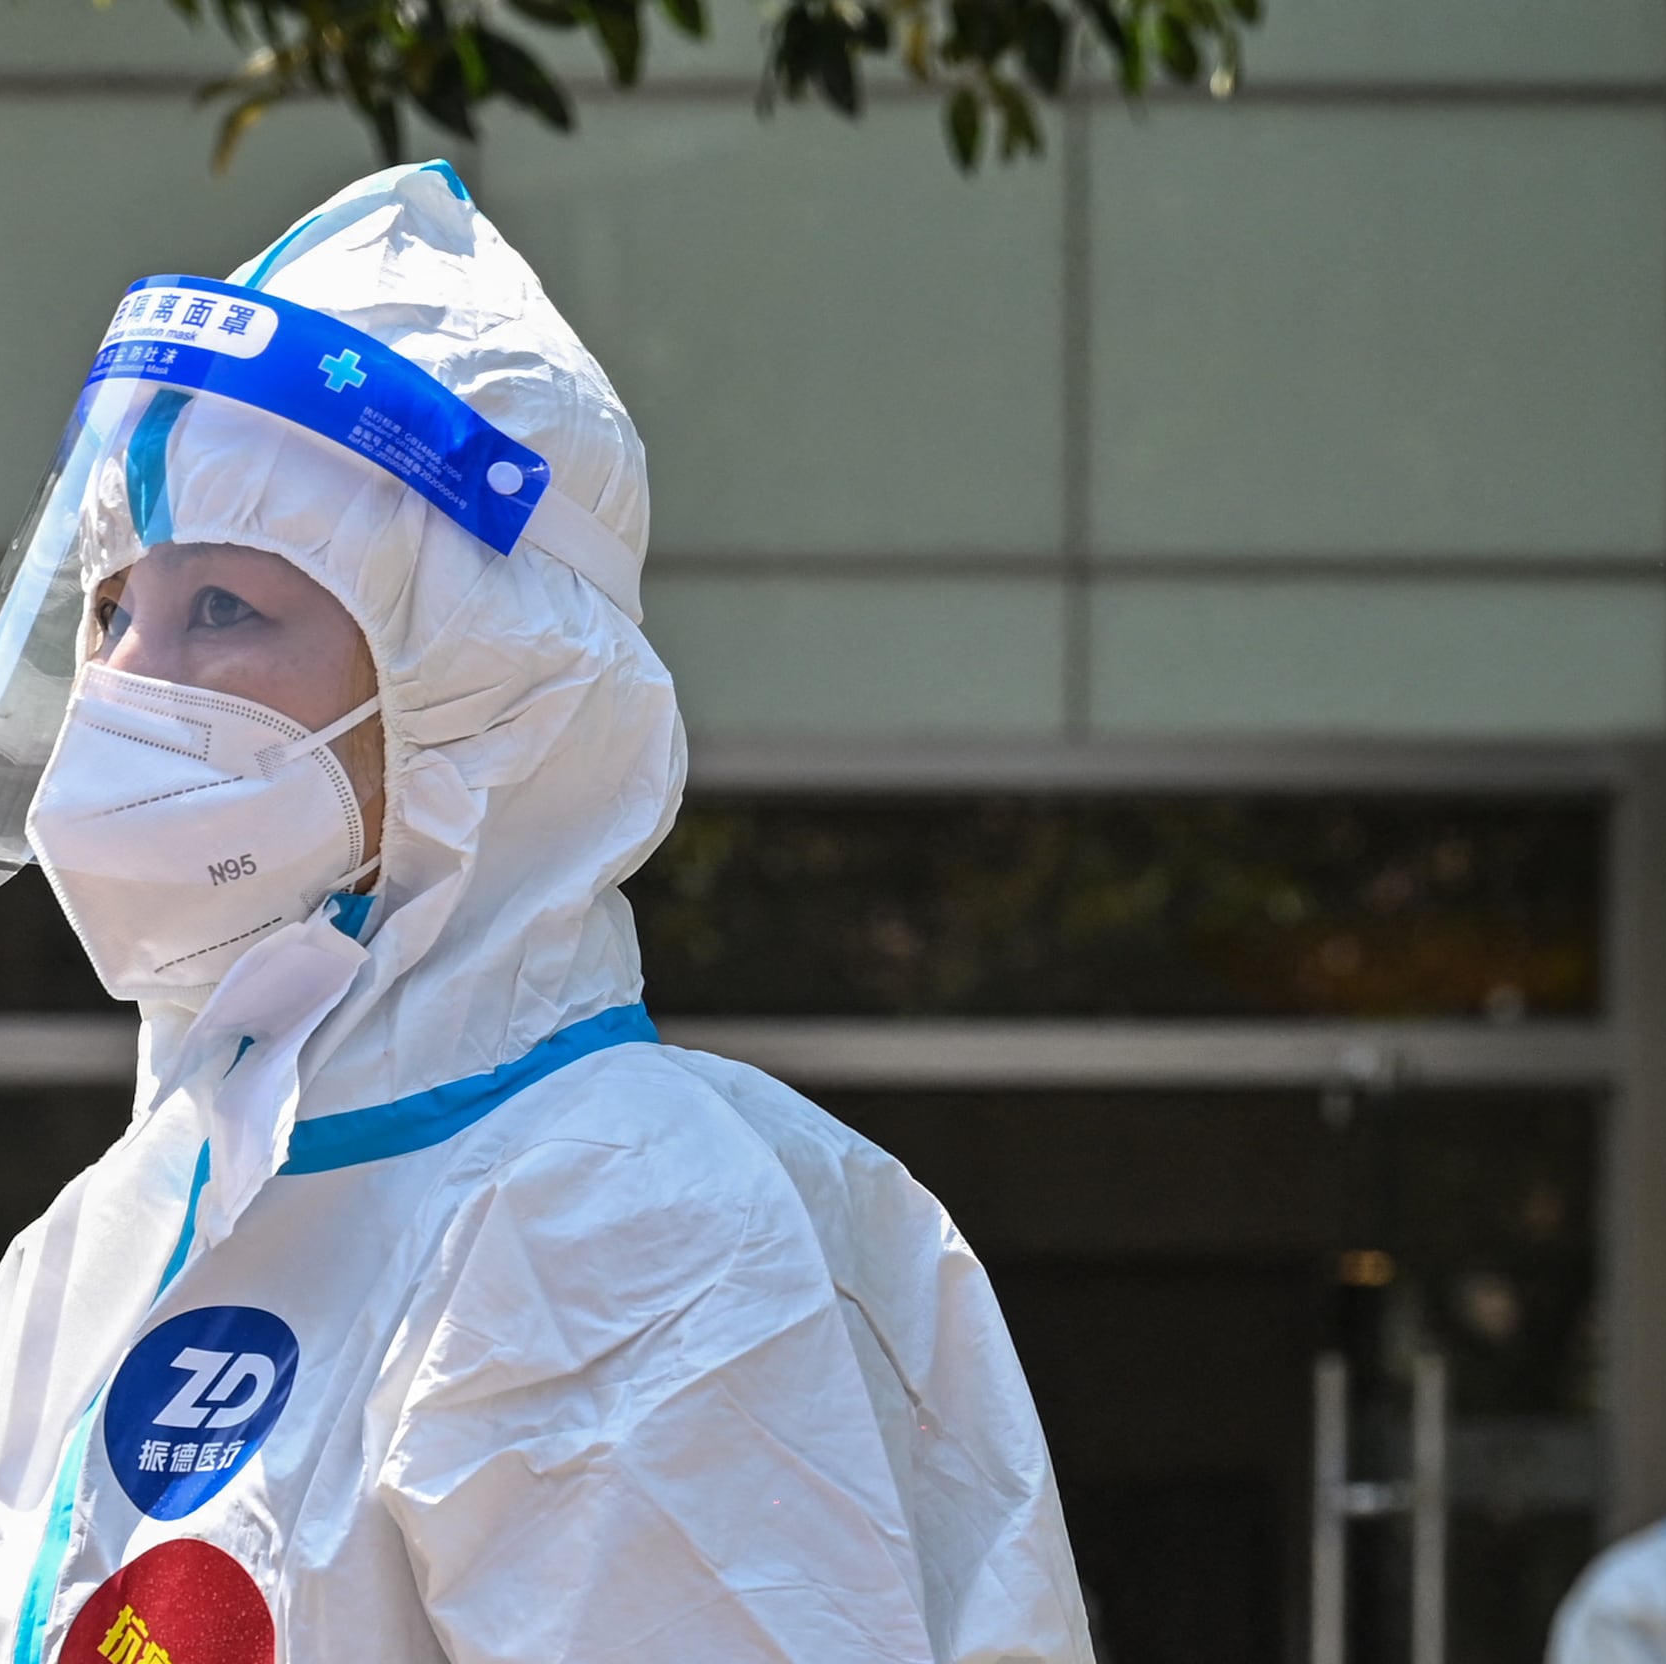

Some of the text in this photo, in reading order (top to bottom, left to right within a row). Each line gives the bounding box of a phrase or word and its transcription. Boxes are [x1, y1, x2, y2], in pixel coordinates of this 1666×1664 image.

[165, 328, 199, 342] mask
[207, 853, 257, 886] N95
[152, 1347, 276, 1428] ZD
[138, 1438, 245, 1473] 振德医疗
